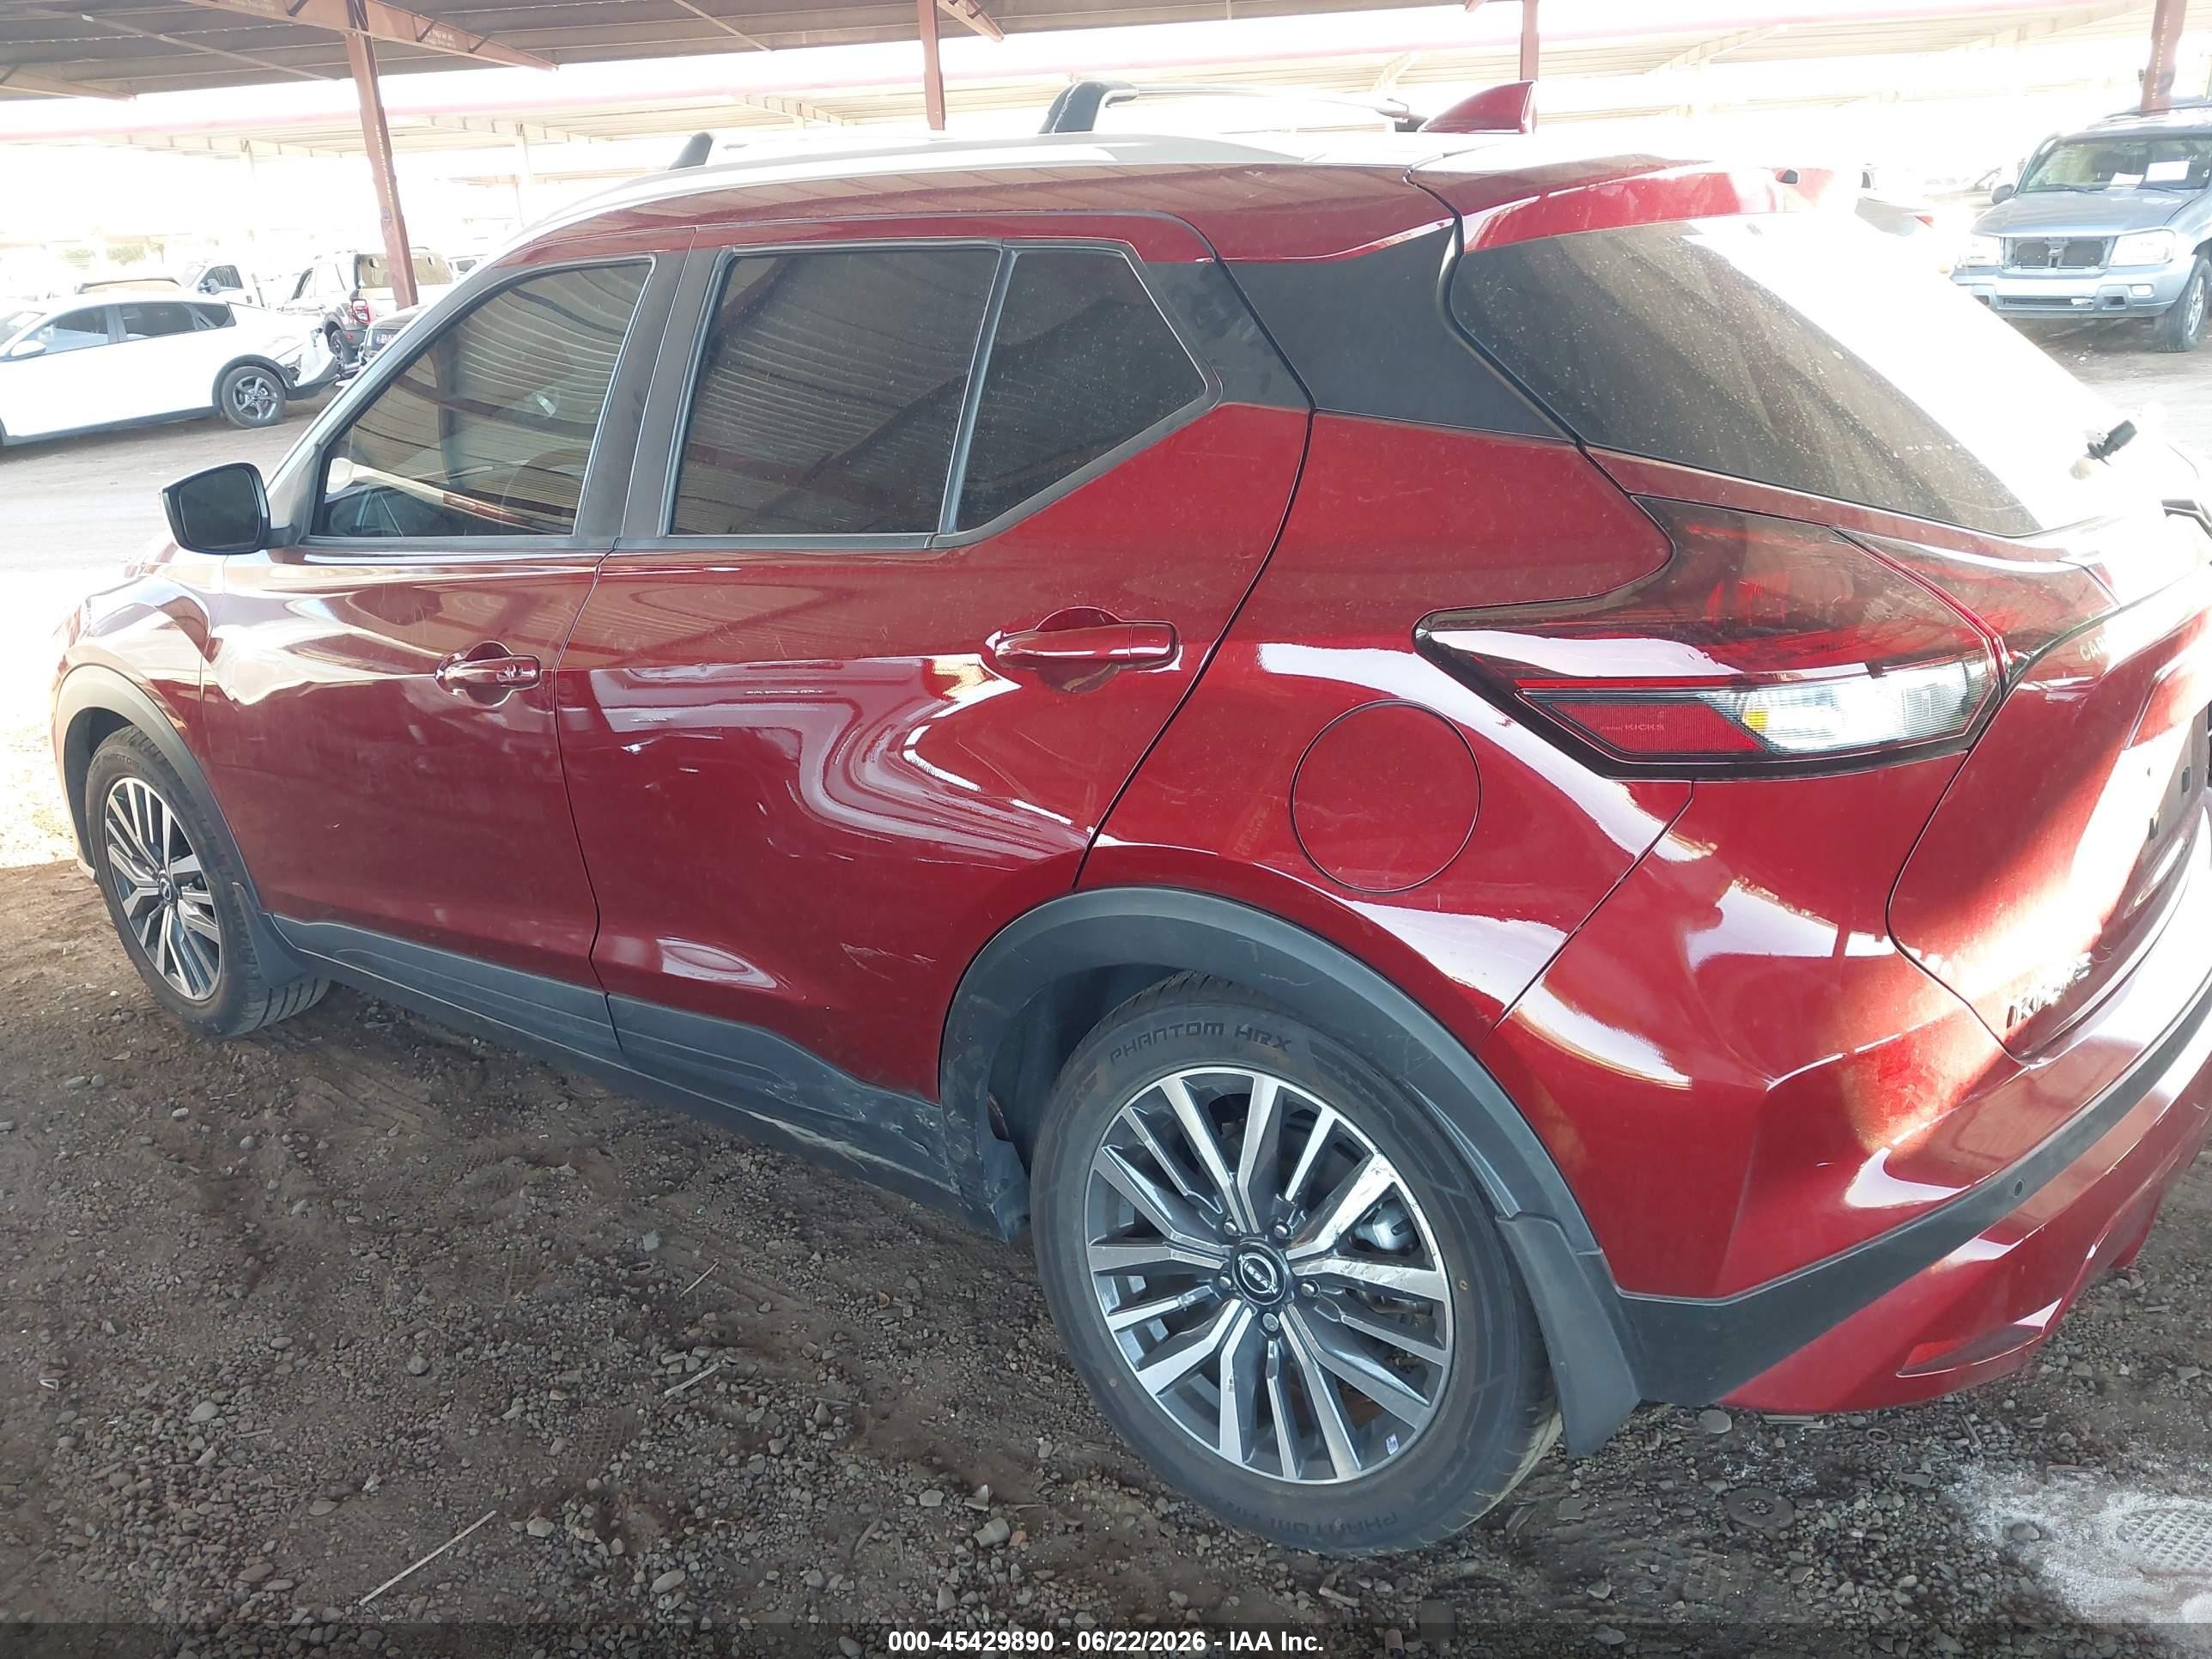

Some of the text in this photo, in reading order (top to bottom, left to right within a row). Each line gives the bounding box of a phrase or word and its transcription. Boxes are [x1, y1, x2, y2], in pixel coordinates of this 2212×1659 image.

[1625, 722, 1665, 731] KICKS
[1109, 1022, 1292, 1065] PHANTOM HRX
[1237, 1254, 1278, 1294] NISSAN
